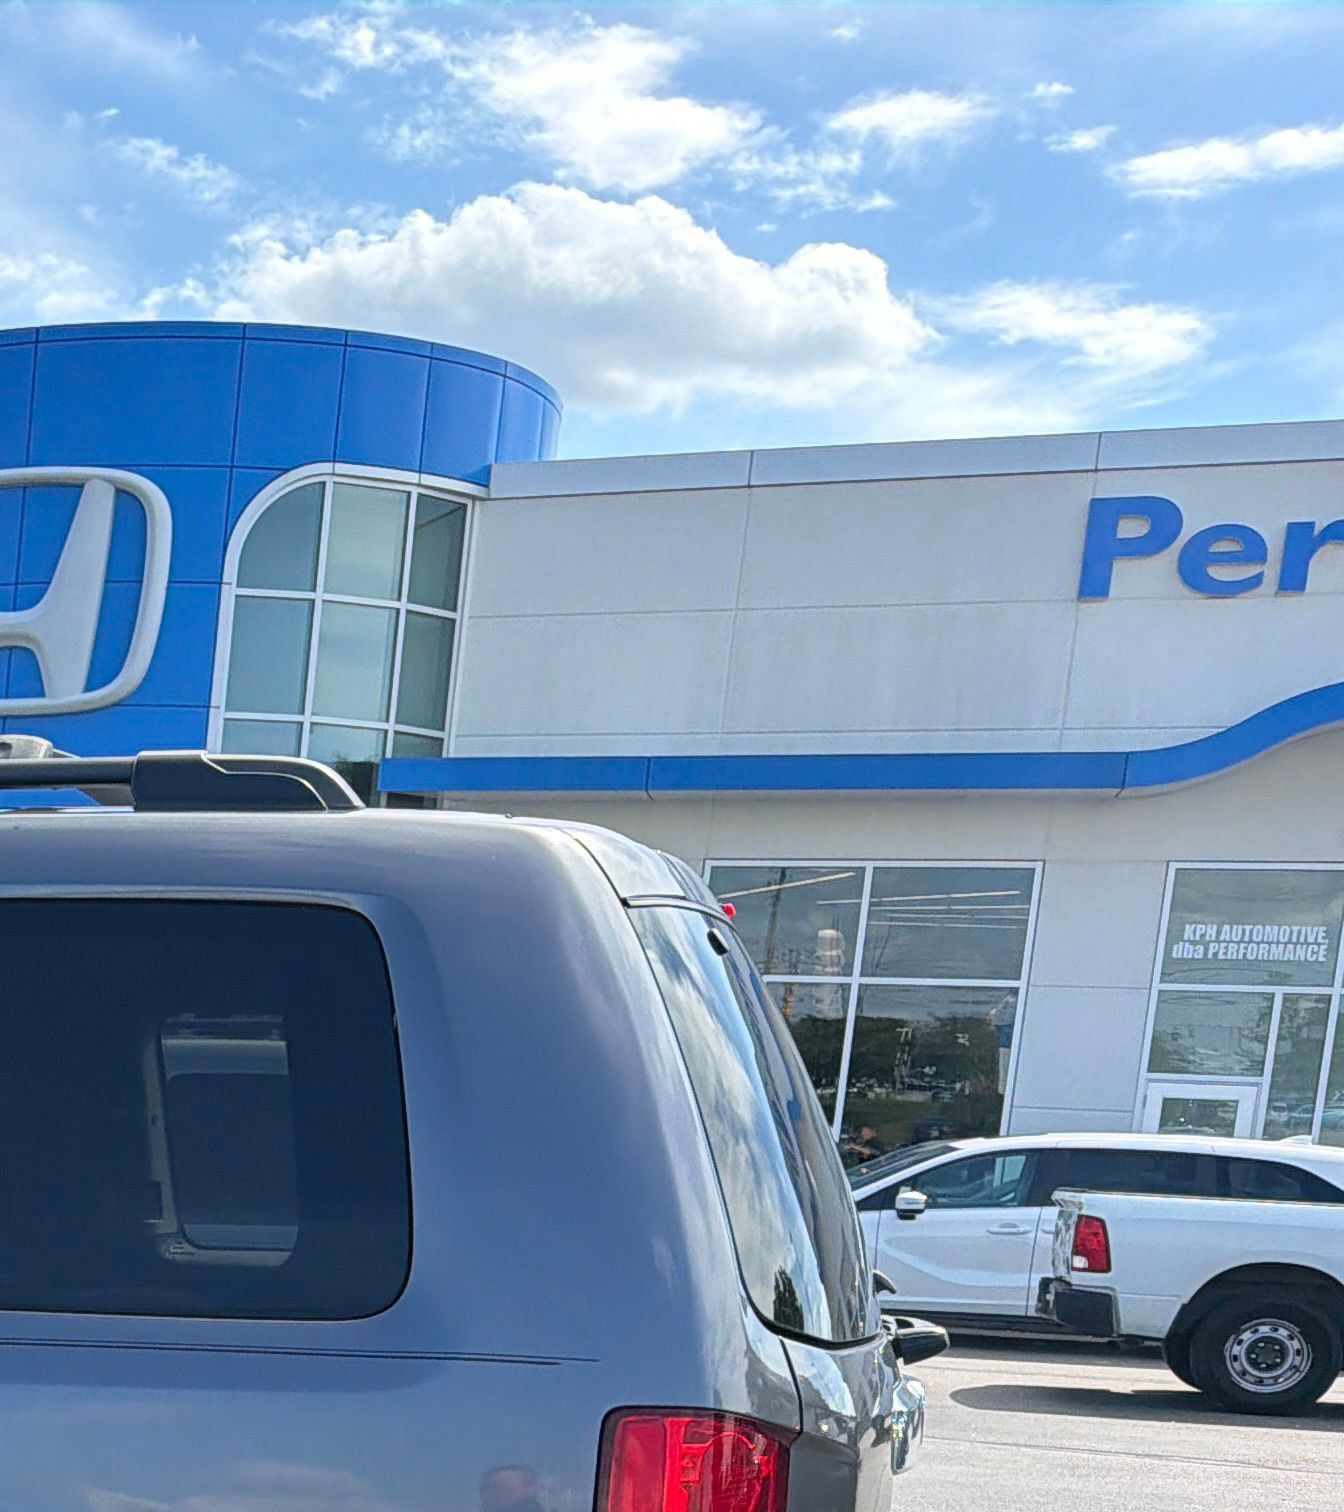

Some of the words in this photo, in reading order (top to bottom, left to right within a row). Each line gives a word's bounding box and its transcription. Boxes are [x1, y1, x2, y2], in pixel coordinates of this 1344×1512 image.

[1183, 923, 1218, 941] KPH
[1172, 942, 1204, 959] dba
[1208, 942, 1328, 962] PERFORMANCE
